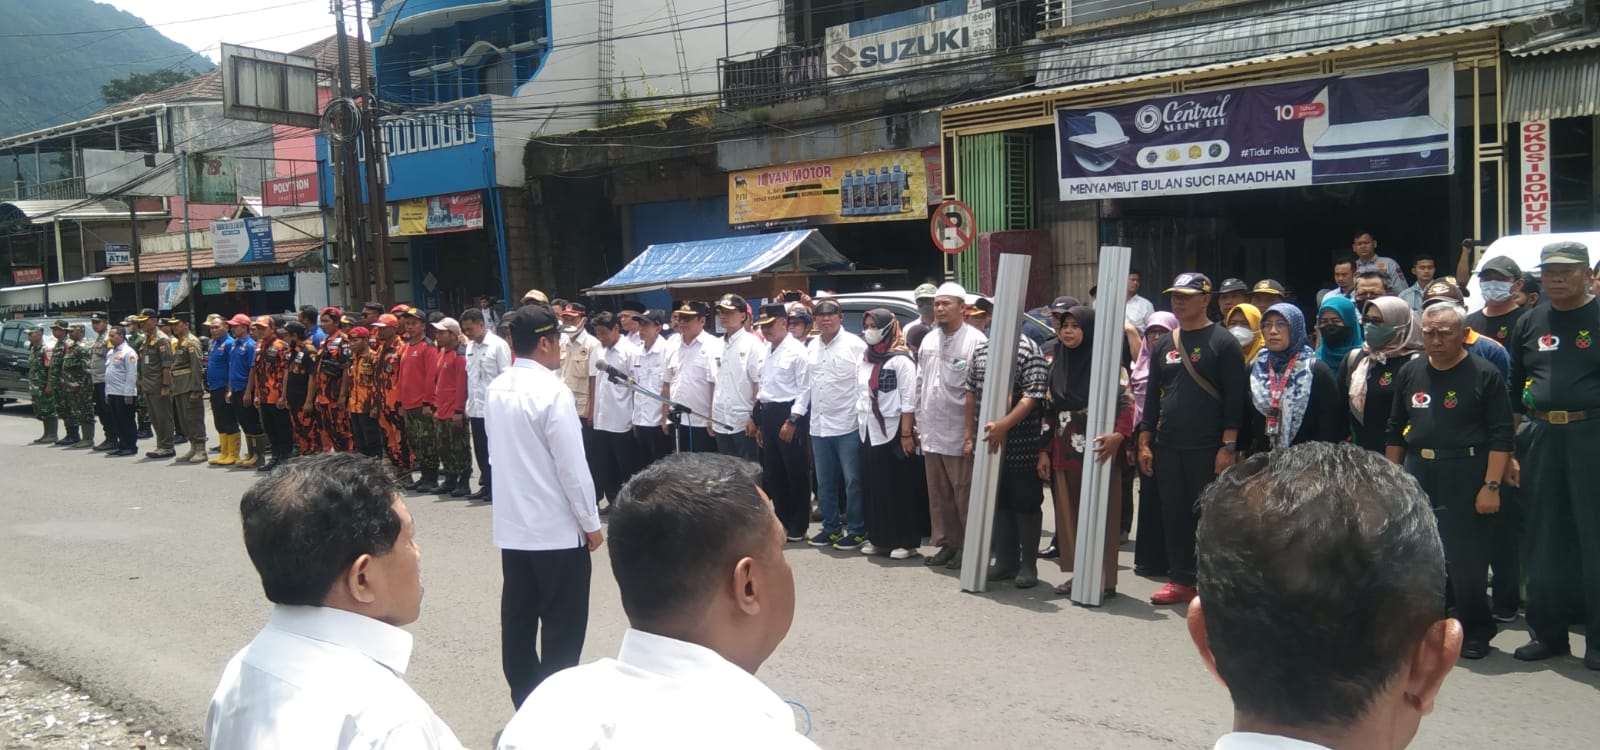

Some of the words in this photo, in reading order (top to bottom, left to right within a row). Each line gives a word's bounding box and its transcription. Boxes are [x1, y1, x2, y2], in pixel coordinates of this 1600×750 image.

[859, 26, 969, 68] SUZUKI
[1162, 94, 1231, 123] Central
[1273, 104, 1294, 121] 10
[1240, 146, 1272, 158] #Tidur
[1273, 145, 1300, 155] Relax
[792, 165, 832, 181] MOTOR
[1069, 180, 1139, 195] MENYAMBUT
[1141, 176, 1182, 191] BULAN
[1185, 174, 1215, 188] SUCI
[1217, 168, 1296, 186] RAMADHAN
